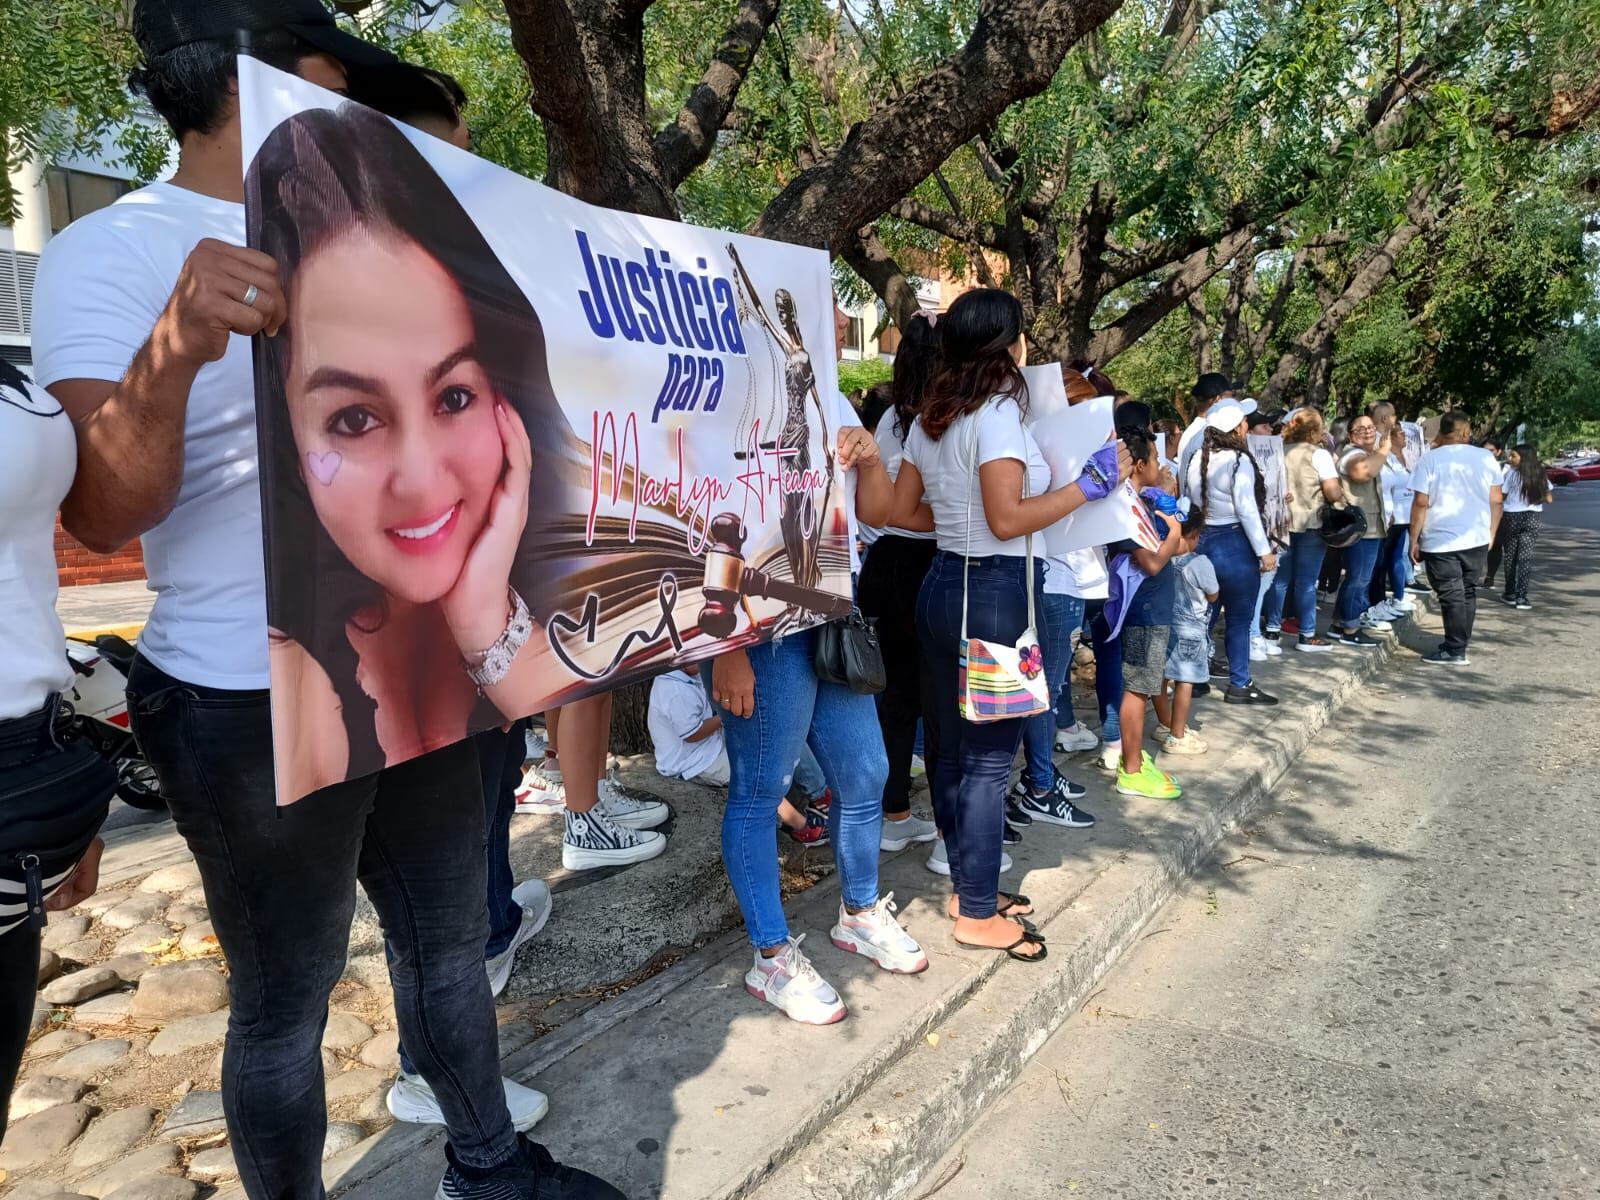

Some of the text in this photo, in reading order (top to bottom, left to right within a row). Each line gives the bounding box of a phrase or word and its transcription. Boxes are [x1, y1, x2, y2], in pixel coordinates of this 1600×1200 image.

[575, 230, 744, 354] Justicia
[652, 353, 725, 422] para
[587, 411, 826, 554] Marlyn Arteaga
